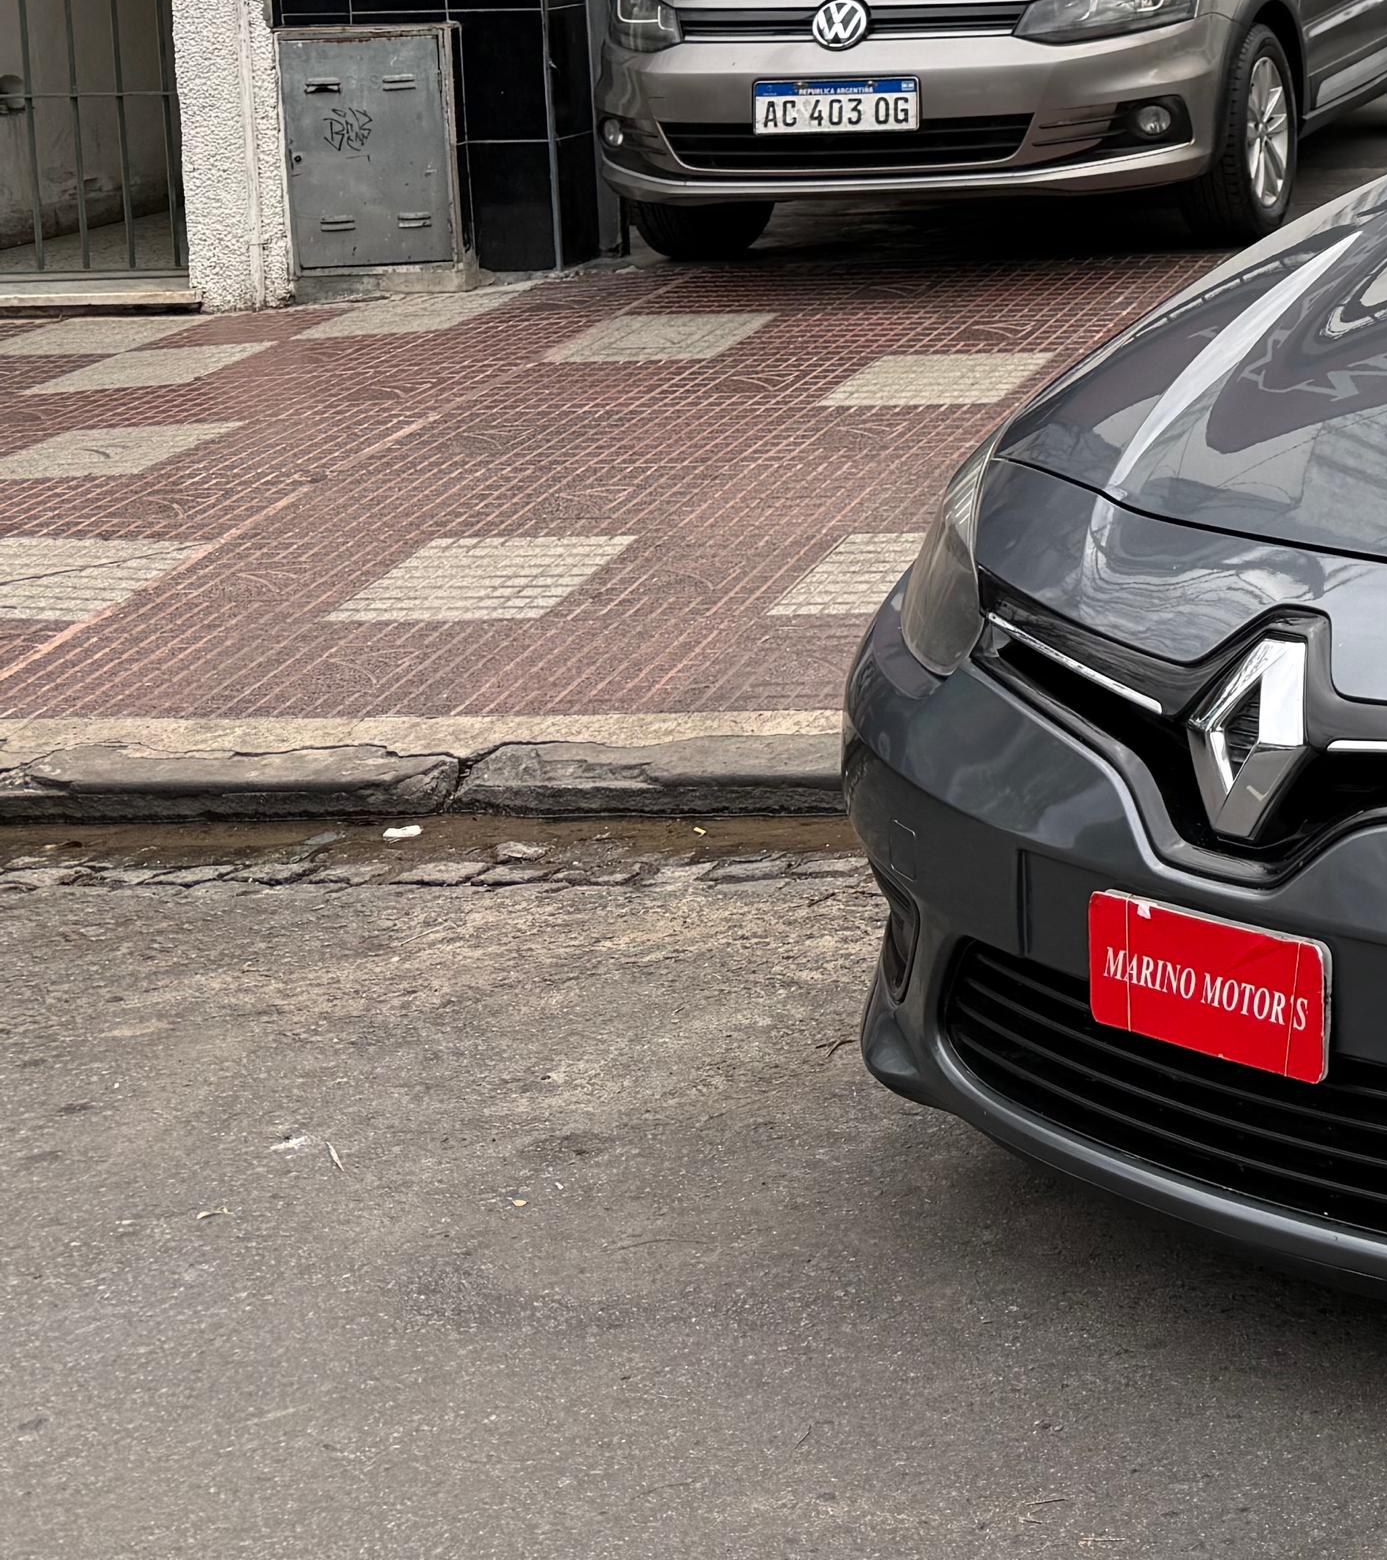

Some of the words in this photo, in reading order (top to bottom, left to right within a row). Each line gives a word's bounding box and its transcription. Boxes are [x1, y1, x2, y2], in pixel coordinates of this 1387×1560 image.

[763, 100, 797, 128] AC
[809, 98, 863, 127] 403
[1103, 946, 1196, 999] MARINO
